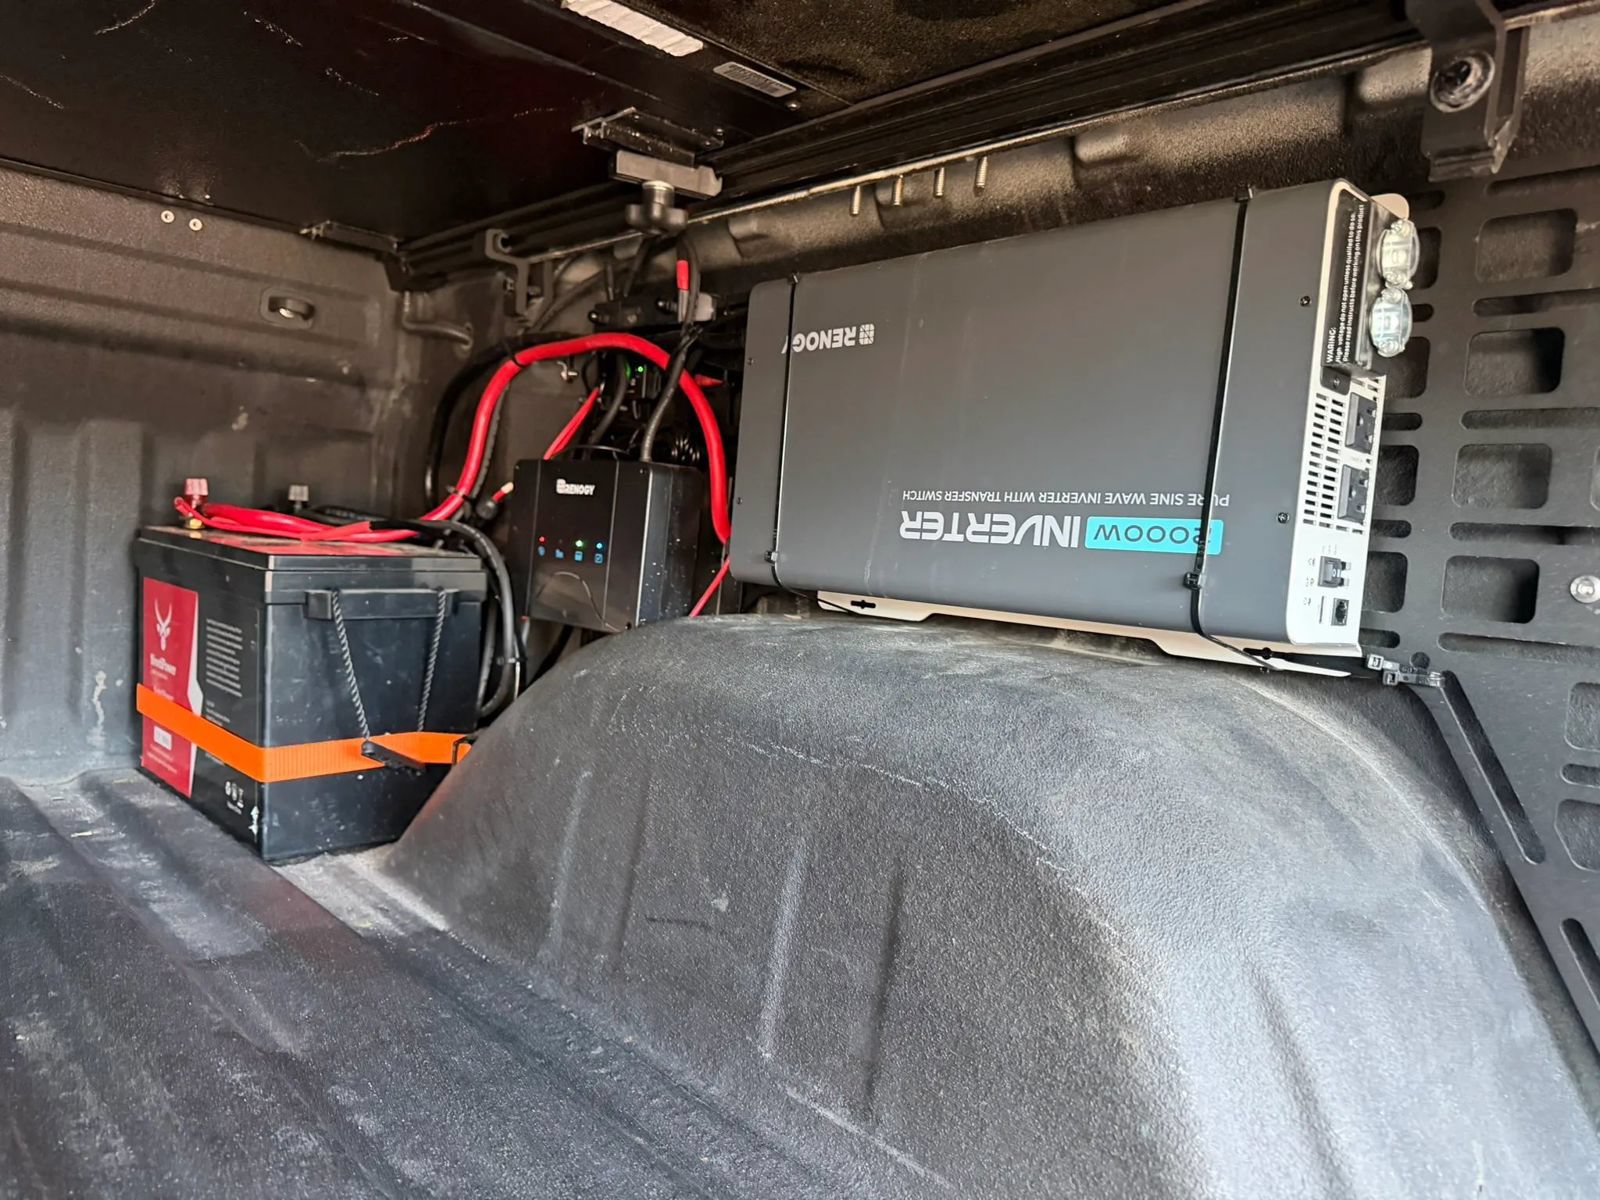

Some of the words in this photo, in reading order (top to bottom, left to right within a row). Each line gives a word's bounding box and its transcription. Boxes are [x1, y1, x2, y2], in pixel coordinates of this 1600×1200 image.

[1355, 242, 1360, 251] on
[1352, 252, 1361, 277] working
[1339, 313, 1346, 322] do
[1349, 222, 1355, 230] do
[1343, 341, 1351, 362] Please
[902, 490, 943, 502] SWITCH
[944, 490, 1001, 502] TRANSFER
[1004, 490, 1036, 503] WITH
[1038, 491, 1102, 504] INVERTER
[1104, 492, 1146, 505] WAVE
[1150, 492, 1184, 506] SINE
[899, 510, 1081, 548] INVERTER
